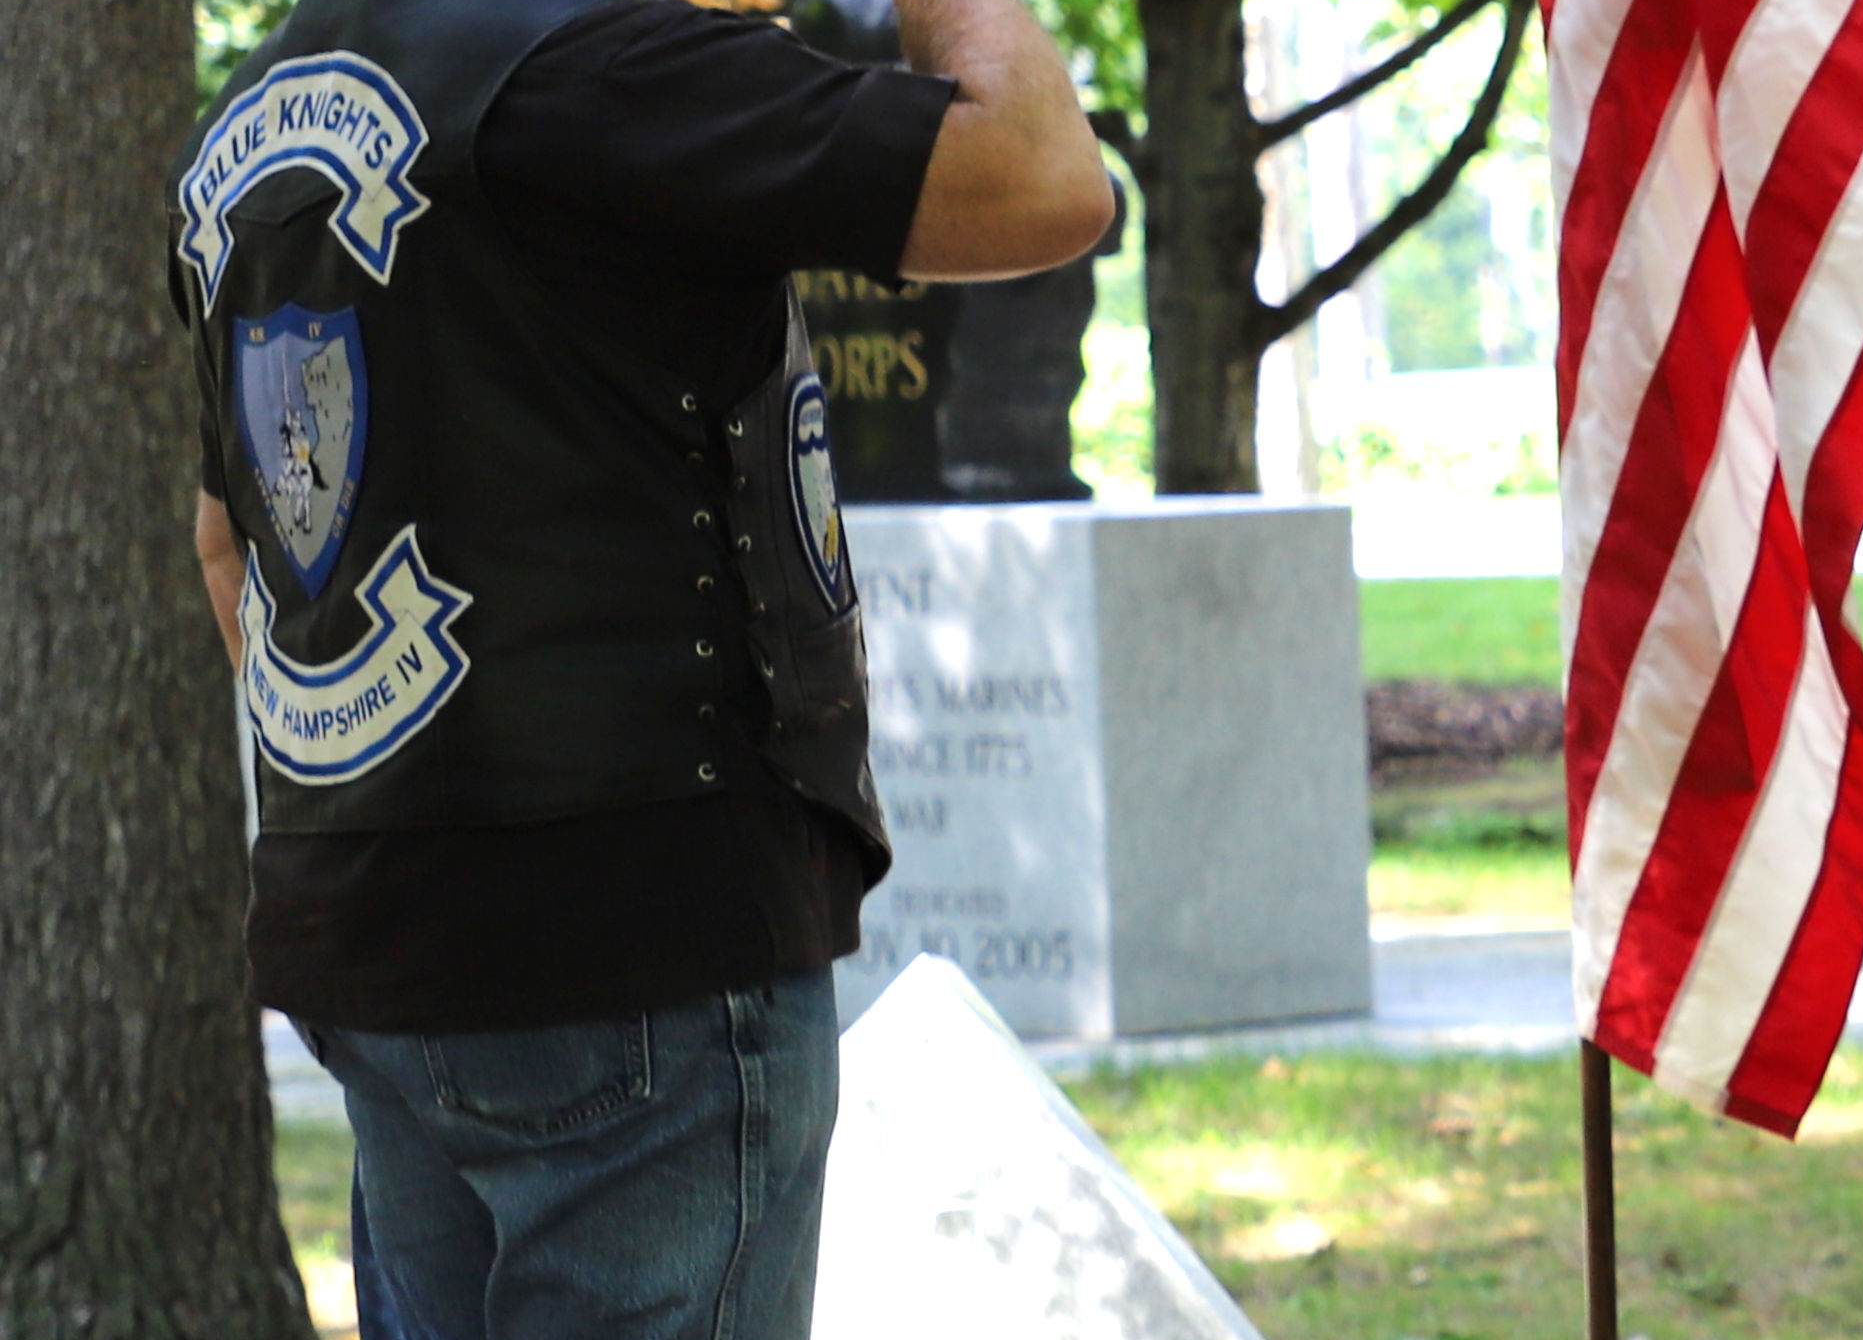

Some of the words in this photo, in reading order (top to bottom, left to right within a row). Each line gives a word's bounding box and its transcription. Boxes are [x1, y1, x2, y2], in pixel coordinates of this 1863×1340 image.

[199, 110, 267, 208] BLUE
[278, 90, 393, 170] KNIGHTS
[811, 329, 929, 401] ORPS
[250, 654, 279, 718] NEW
[282, 672, 396, 742] HAMPSHIRE
[395, 640, 424, 686] IV
[973, 927, 1075, 981] 2005
